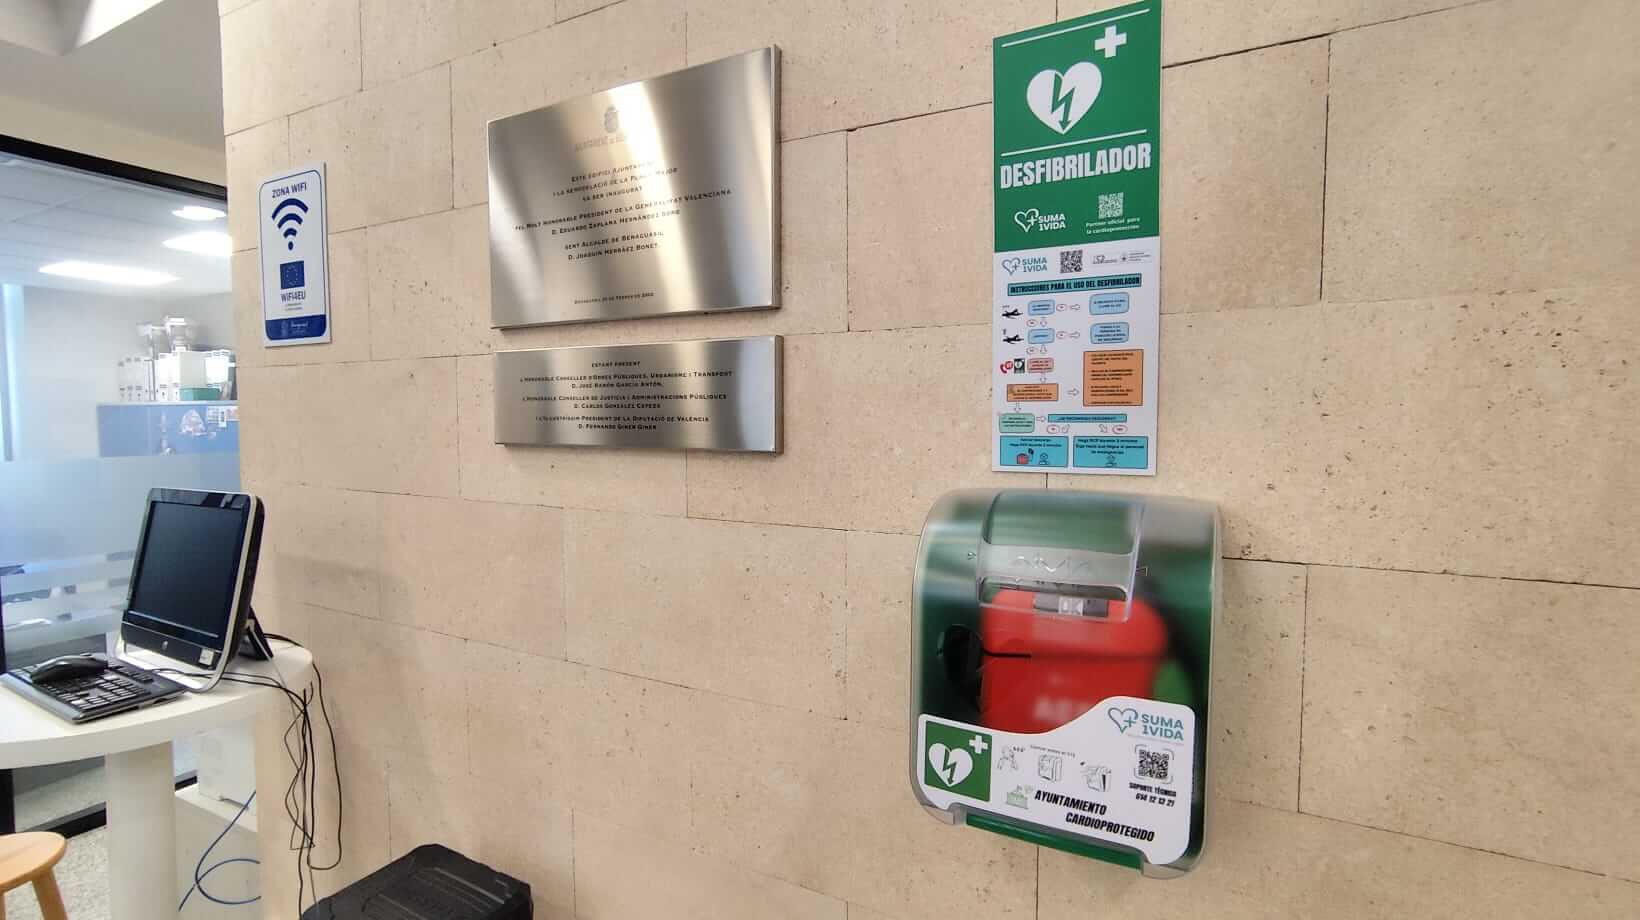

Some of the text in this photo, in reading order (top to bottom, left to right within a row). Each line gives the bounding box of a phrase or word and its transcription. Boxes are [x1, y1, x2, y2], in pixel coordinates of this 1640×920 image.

[1000, 143, 1152, 189] DESFIBRILADOR
[272, 182, 307, 198] ZONA WIFI
[684, 189, 732, 201] VALENCIANA
[1038, 213, 1066, 223] SUMA
[1022, 257, 1047, 266] SUMA
[1051, 281, 1065, 291] PARA
[1066, 281, 1074, 290] EL
[1074, 279, 1085, 289] USO
[1086, 278, 1096, 288] DEL
[1097, 275, 1140, 287] DESFIBRILADOR
[693, 370, 733, 378] TRANSPORT
[1141, 713, 1185, 730] SUMA
[1143, 724, 1185, 741] 1VIDA
[1129, 782, 1177, 797] SOPORTE TÉCNICO
[1135, 793, 1148, 801] 614
[1035, 789, 1107, 816] AYUNTAMIENTO
[1066, 812, 1155, 842] CARDIOPROTEGIDO
